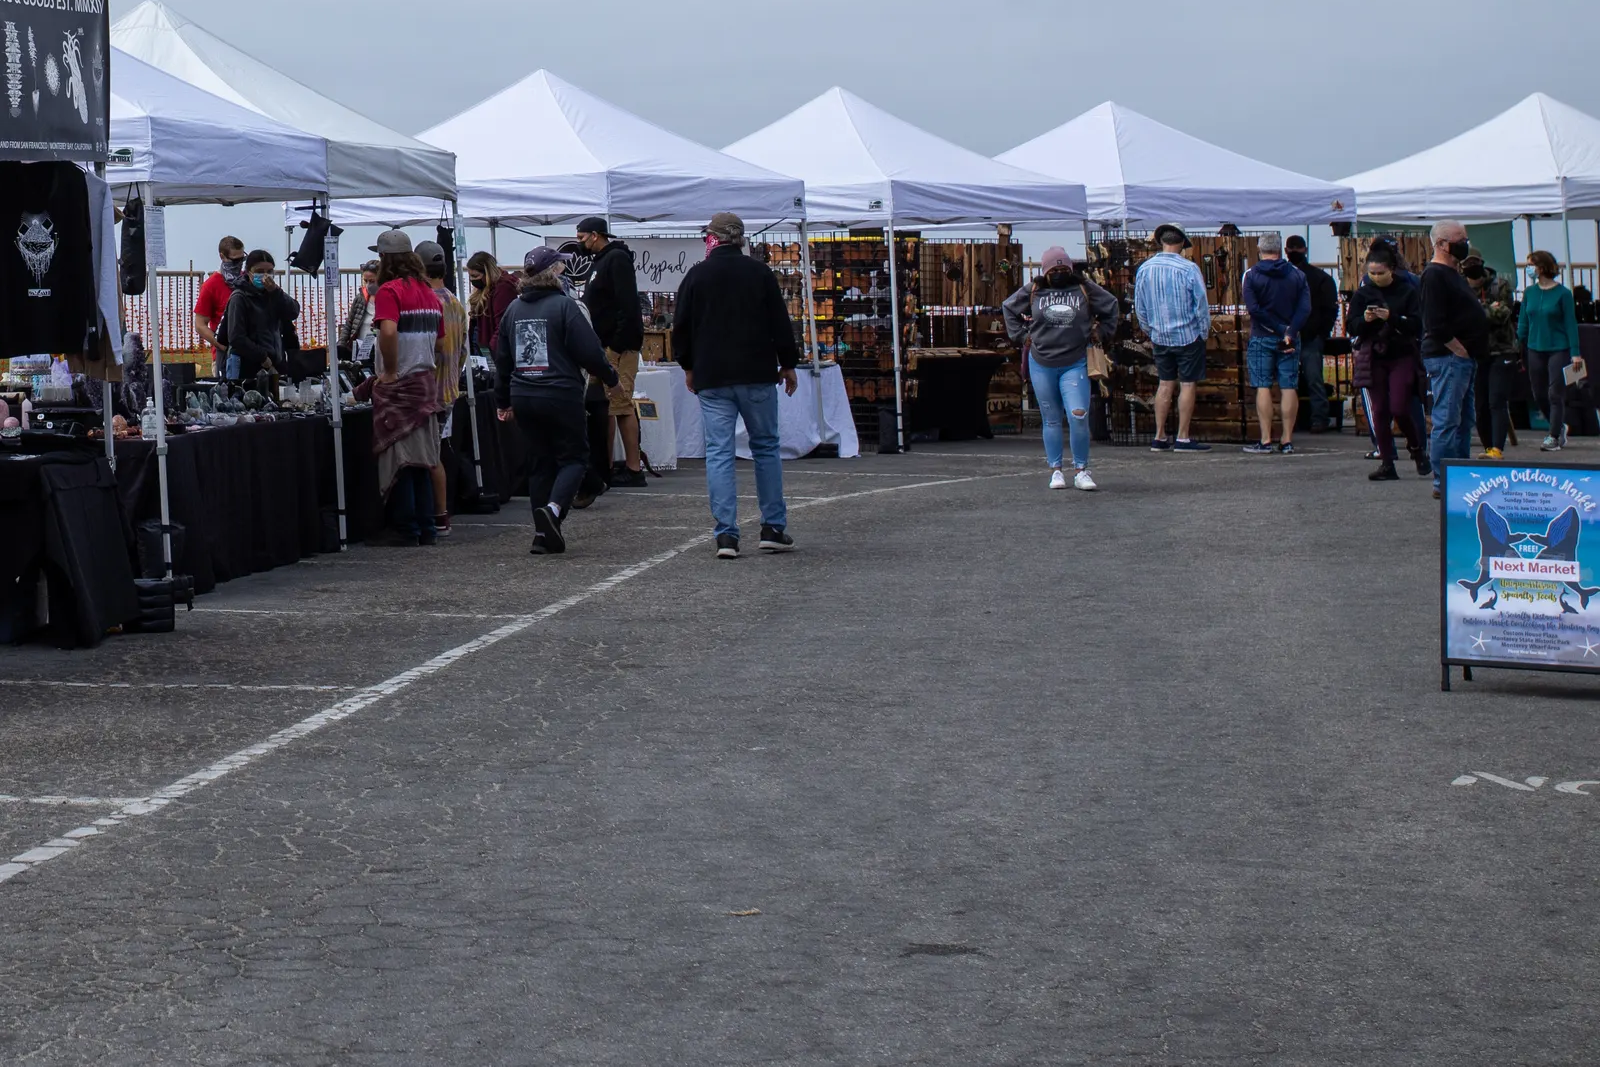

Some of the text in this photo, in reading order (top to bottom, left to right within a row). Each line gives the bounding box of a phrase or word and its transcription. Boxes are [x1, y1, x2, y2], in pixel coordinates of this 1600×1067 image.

[10, 141, 20, 149] FROM
[21, 141, 29, 149] SAN
[1039, 295, 1080, 311] CAROLINA
[1462, 469, 1597, 512] Monterey Outdoor Market
[1503, 497, 1522, 505] Sunday
[1518, 544, 1538, 553] FREE!
[1494, 560, 1576, 575] Next Market
[1501, 590, 1534, 603] Specialty
[1502, 629, 1524, 637] Custom
[1491, 635, 1519, 643] Monterey
[1501, 642, 1529, 650] Monterey
